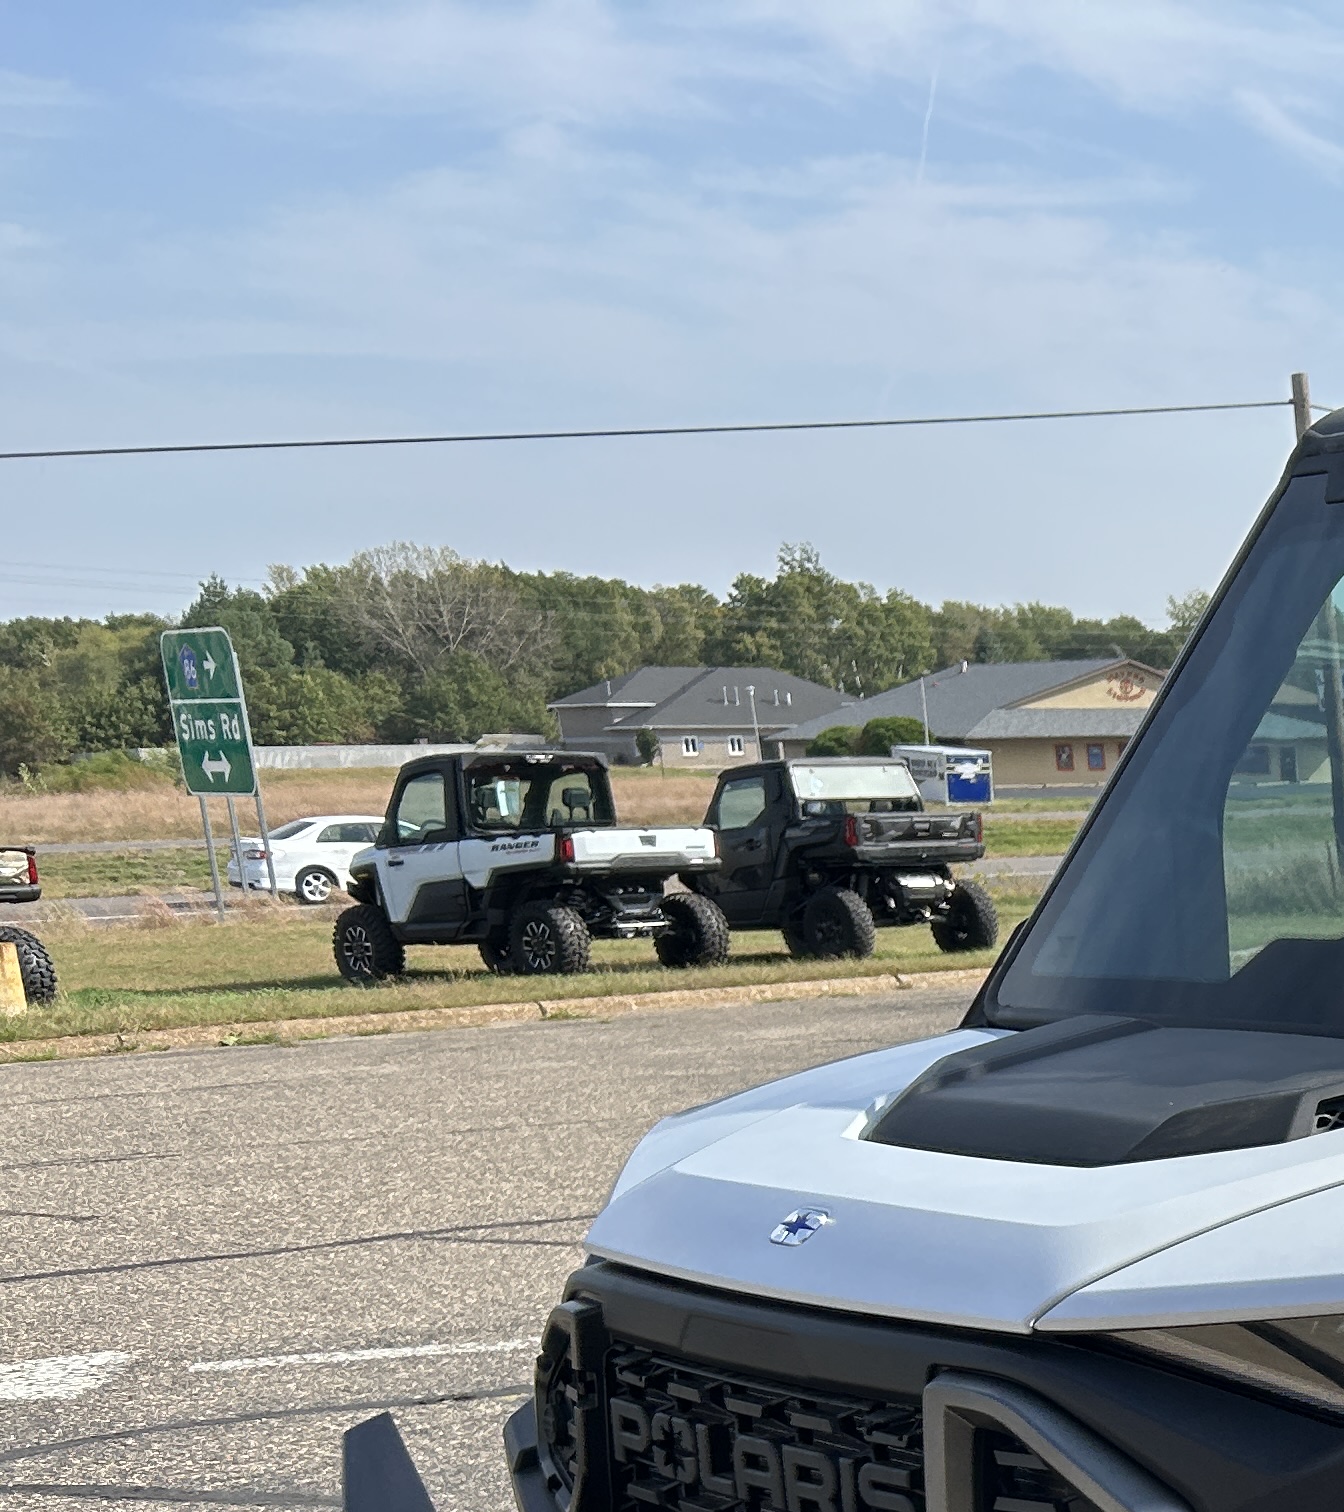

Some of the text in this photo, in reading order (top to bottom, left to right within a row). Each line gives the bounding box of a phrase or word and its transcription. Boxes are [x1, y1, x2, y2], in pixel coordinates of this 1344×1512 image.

[180, 713, 241, 740] Sims Rd
[491, 840, 539, 852] RANGER
